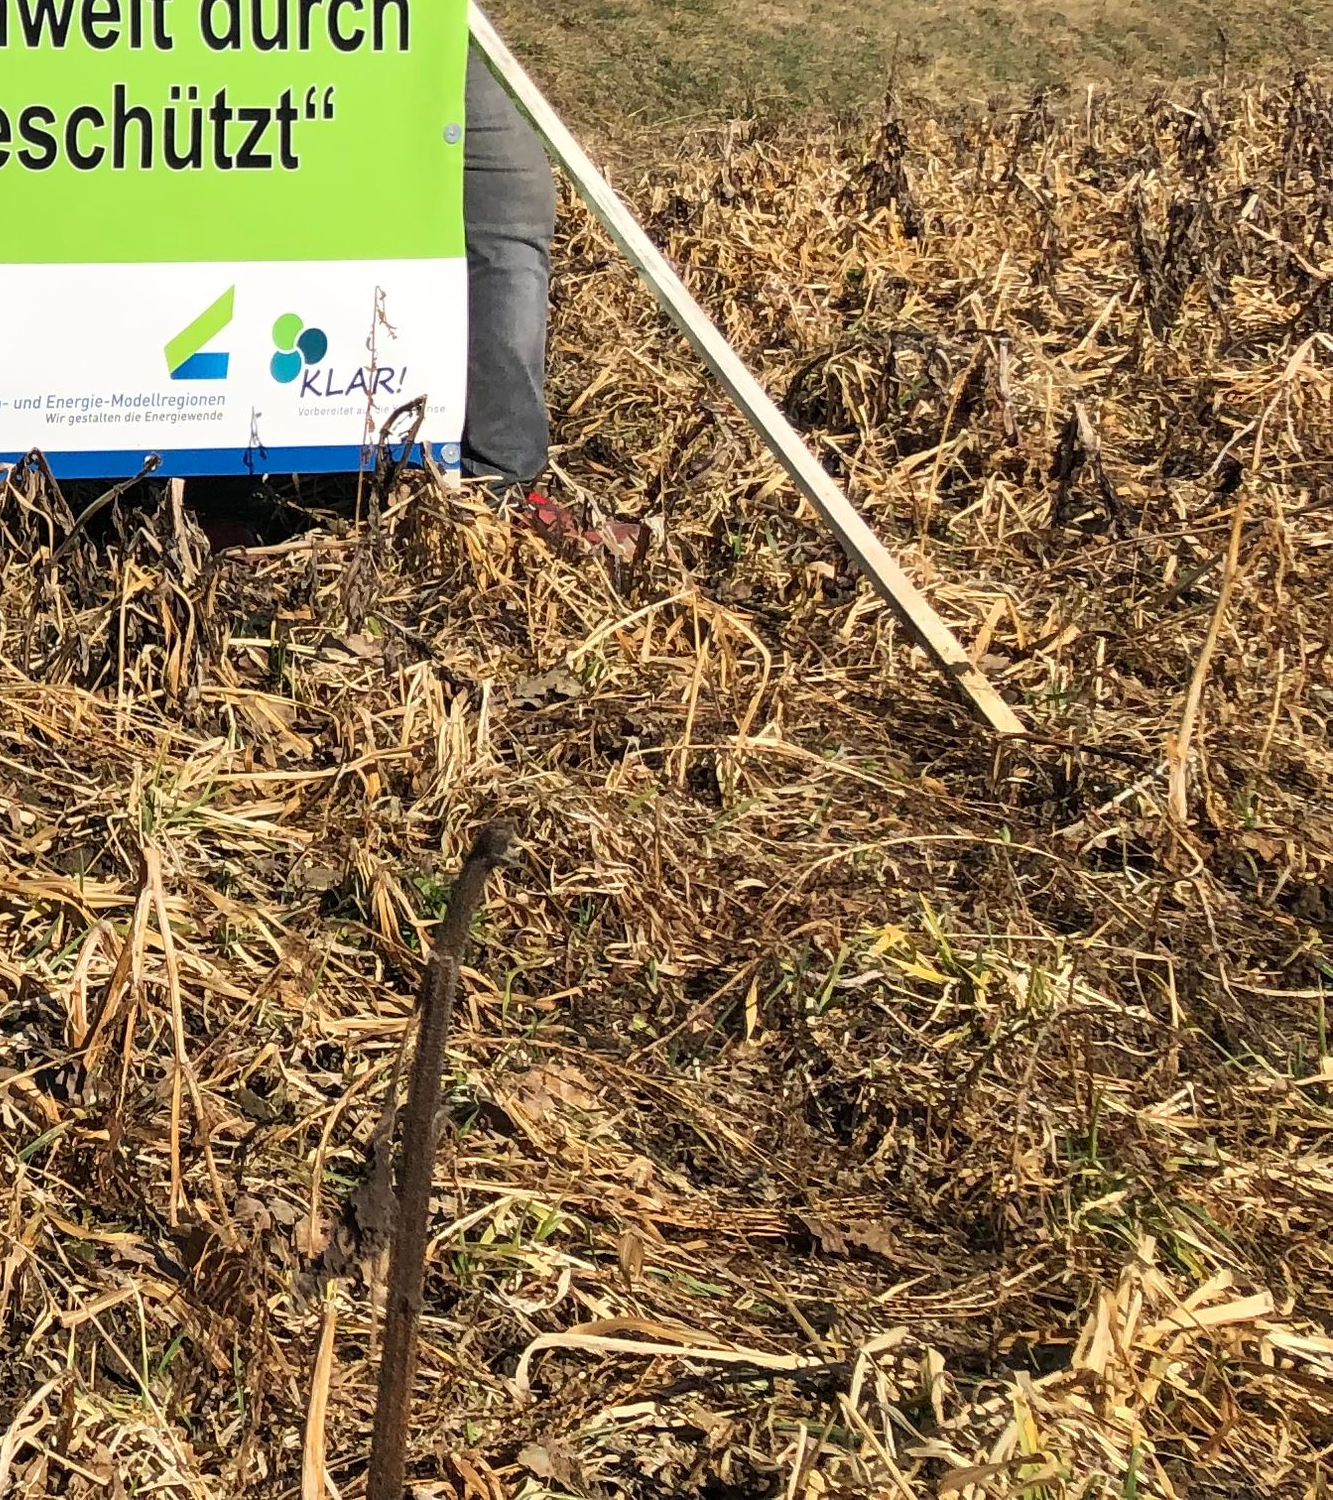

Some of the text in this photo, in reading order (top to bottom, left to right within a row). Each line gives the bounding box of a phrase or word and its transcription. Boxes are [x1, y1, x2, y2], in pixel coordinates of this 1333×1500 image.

[300, 367, 407, 397] KLAR!
[14, 396, 41, 409] und
[46, 393, 225, 412] Energie-Modellregionen
[46, 410, 223, 426] Wir gestalten die Energiewende
[298, 407, 353, 416] Vorbereitet
